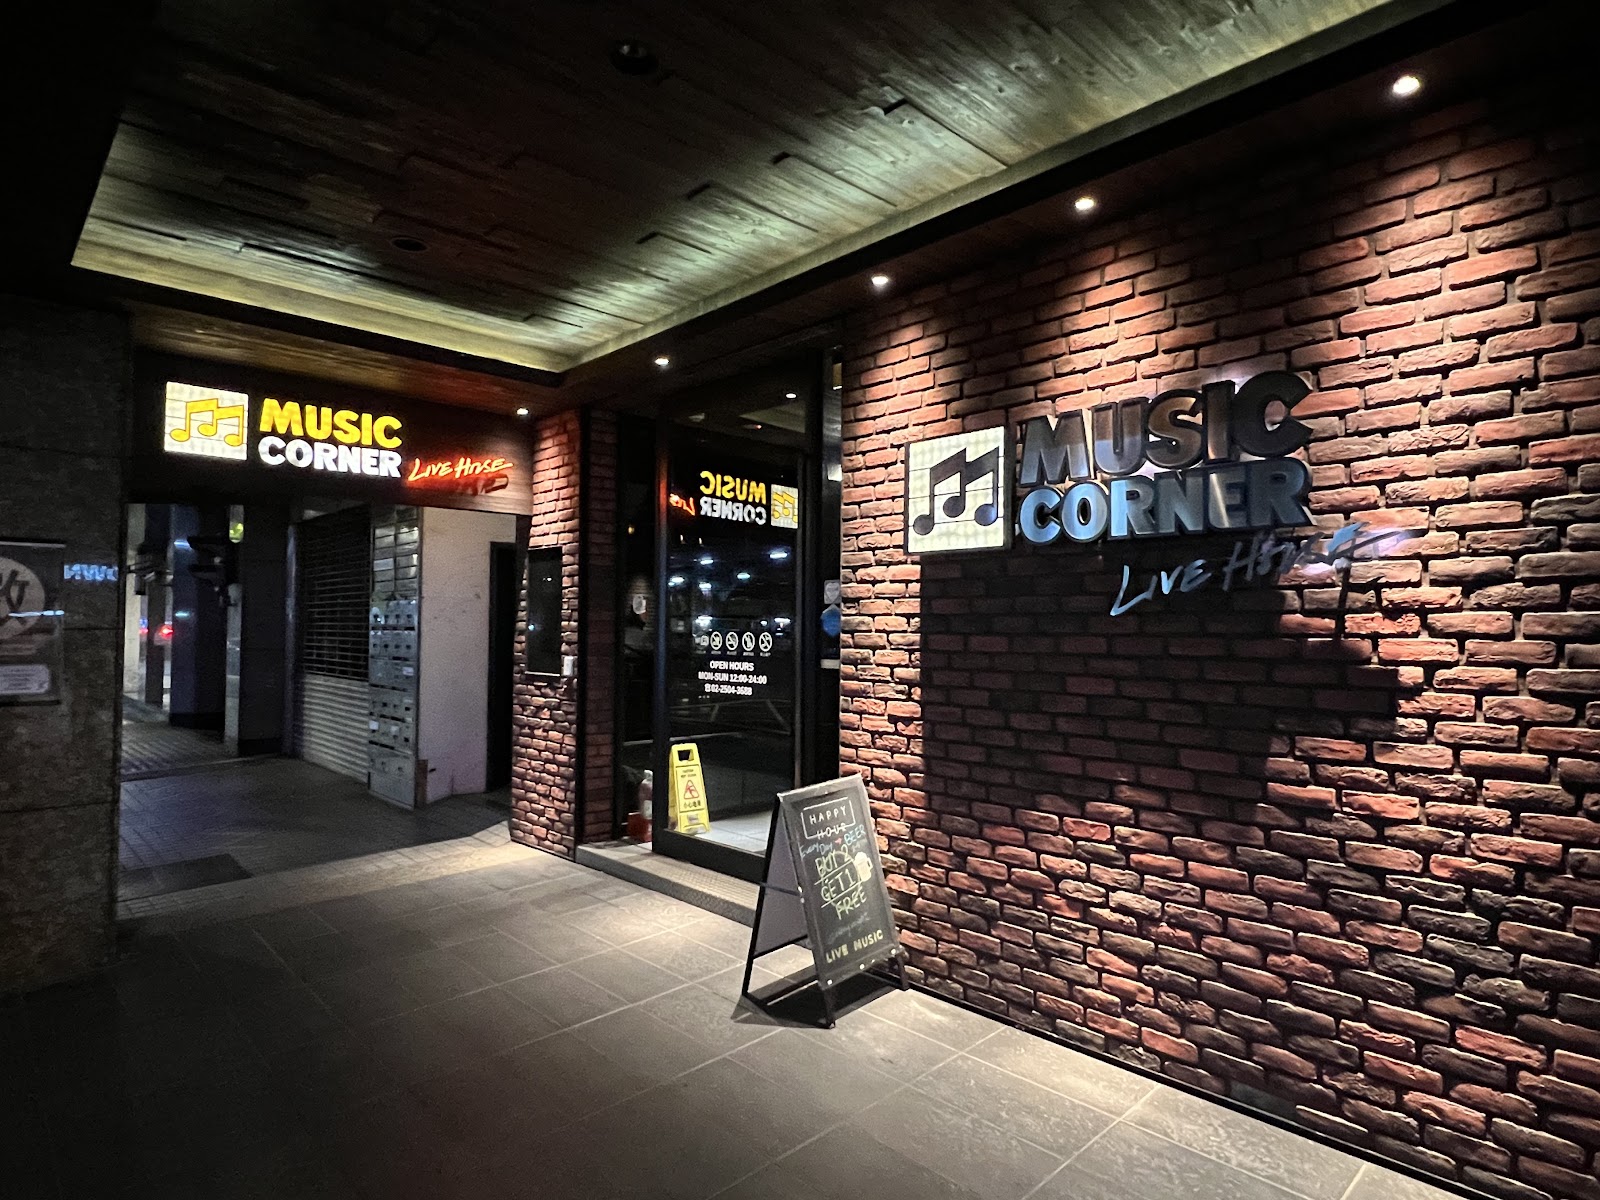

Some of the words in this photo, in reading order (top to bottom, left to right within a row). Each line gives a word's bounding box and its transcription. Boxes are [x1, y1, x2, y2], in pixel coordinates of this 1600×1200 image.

[259, 398, 402, 448] MUSIC
[1019, 370, 1314, 486] MUSIC
[258, 436, 401, 479] CORNER
[1019, 458, 1314, 544] CORNER
[698, 671, 729, 682] MON-SUN
[729, 674, 768, 684] 12:00-24:00
[710, 660, 728, 670] OPEN
[729, 662, 755, 671] HOURS
[809, 805, 846, 825] HAPPY
[816, 822, 847, 840] HOUR
[843, 824, 866, 846] BEER
[815, 849, 838, 877] BUY
[841, 844, 854, 862] 2
[821, 871, 845, 902] GET
[835, 886, 867, 920] FREE
[826, 943, 849, 964] LIVE
[853, 929, 884, 952] MUSIC
